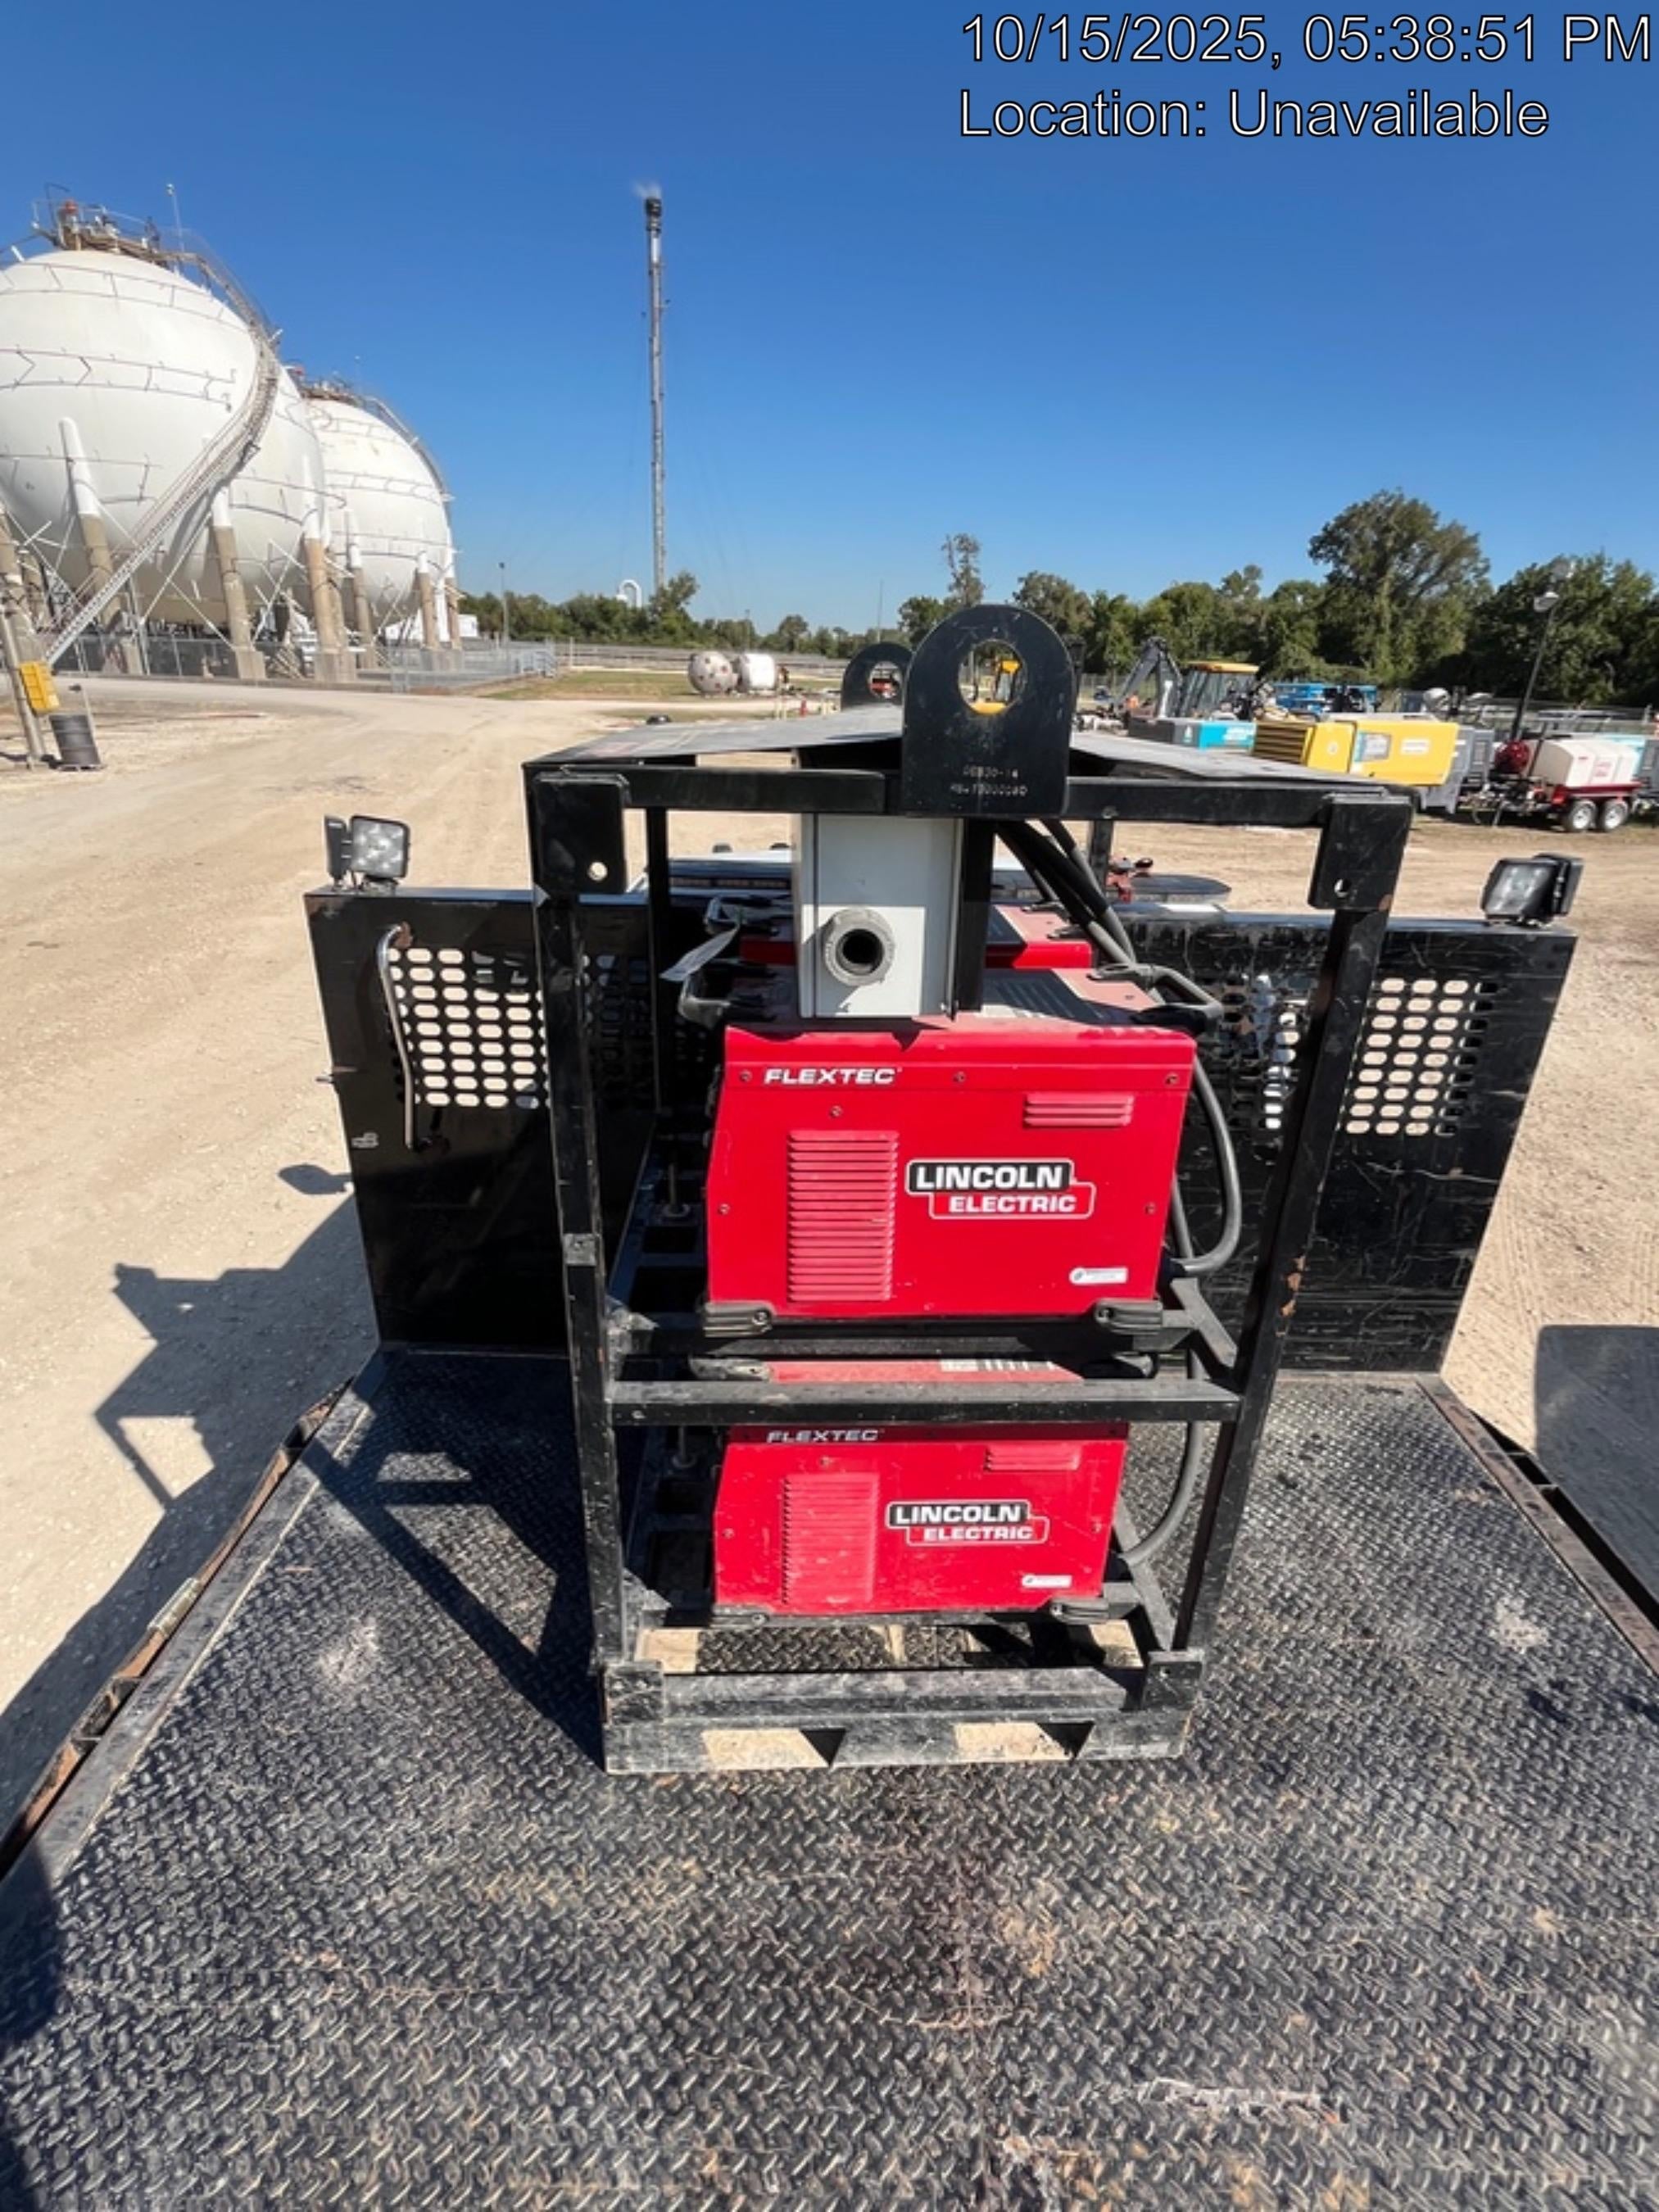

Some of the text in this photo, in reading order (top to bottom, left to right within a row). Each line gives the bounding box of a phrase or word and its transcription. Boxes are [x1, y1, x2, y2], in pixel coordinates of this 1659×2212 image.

[764, 1067, 896, 1085] FLEXTEC
[916, 1166, 1063, 1190] LINCOLN
[949, 1195, 1077, 1213] ELECTRIC
[766, 1430, 879, 1444] FLEXTEC
[896, 1505, 1021, 1524] LINCOLN
[923, 1526, 1033, 1541] ELECTRIC
